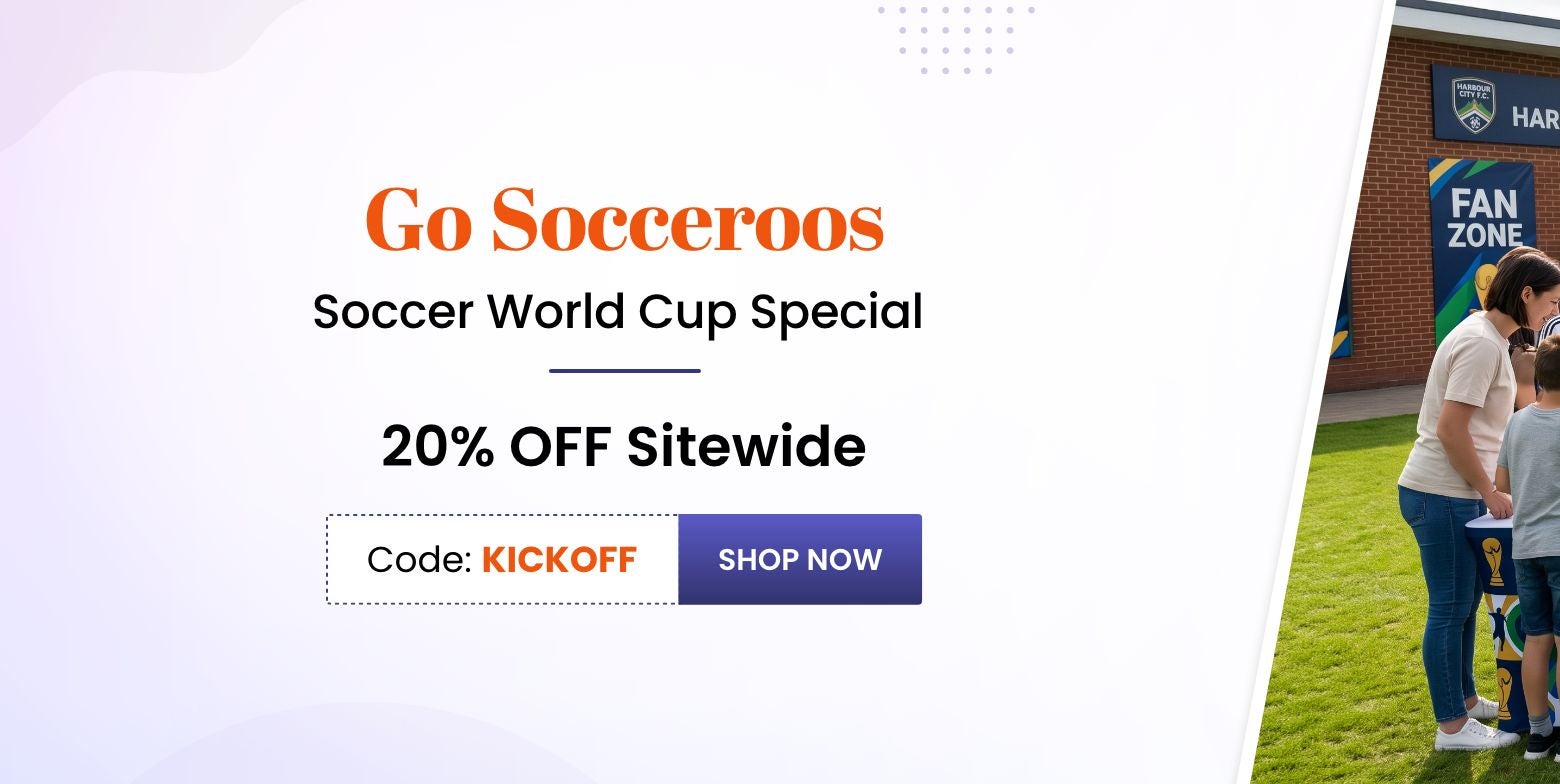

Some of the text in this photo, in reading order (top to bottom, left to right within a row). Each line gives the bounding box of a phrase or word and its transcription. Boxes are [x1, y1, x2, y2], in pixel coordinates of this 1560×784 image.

[1457, 83, 1490, 92] HARBOUR
[1452, 188, 1517, 218] FAN
[1448, 223, 1523, 247] ZONE
